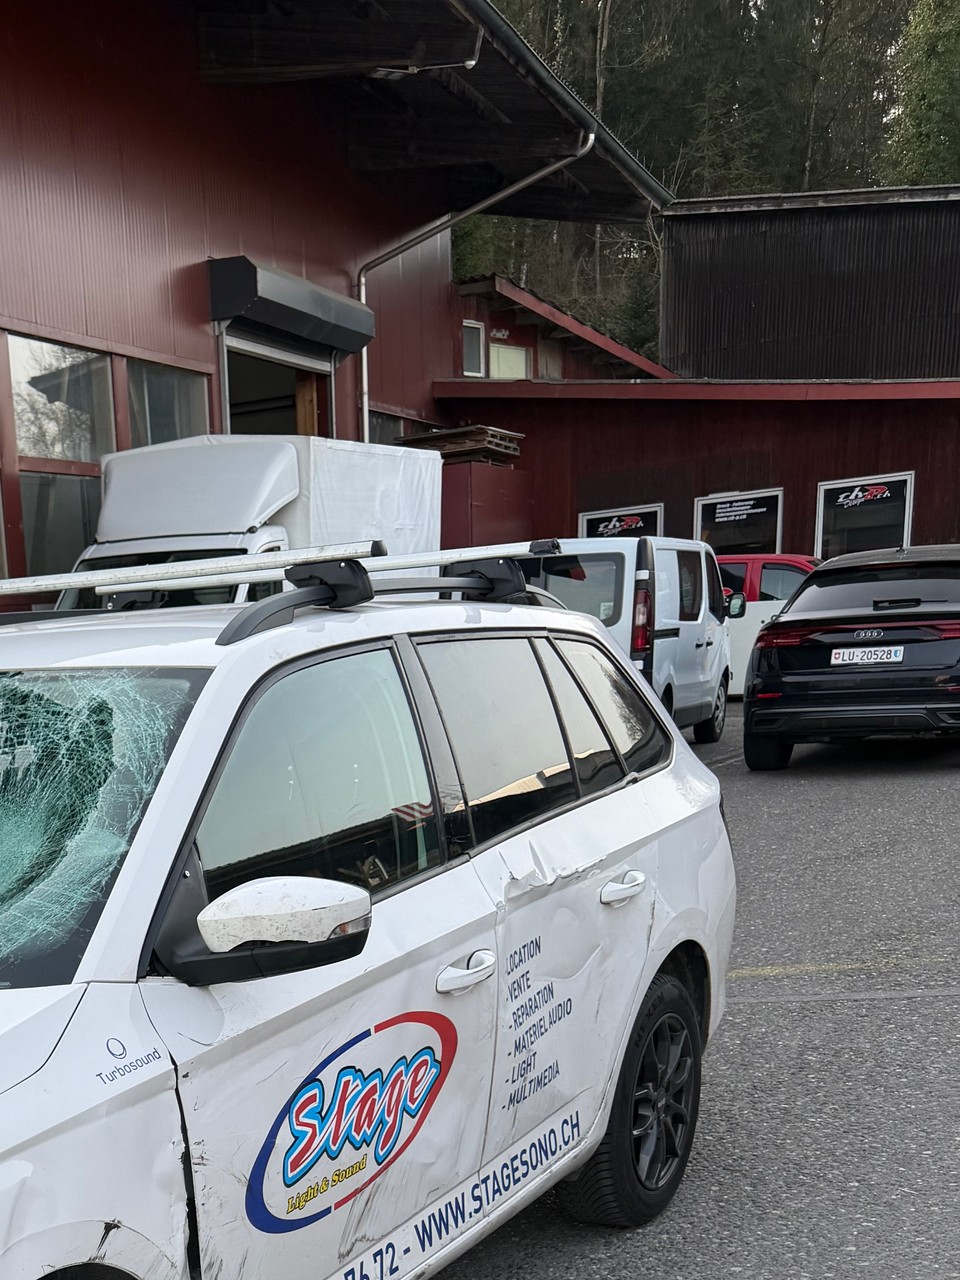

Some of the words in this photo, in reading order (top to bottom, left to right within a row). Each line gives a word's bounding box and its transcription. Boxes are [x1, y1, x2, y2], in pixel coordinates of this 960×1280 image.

[506, 935, 541, 976] LOCATION
[508, 970, 532, 1003] VENTE
[511, 981, 554, 1031] REPARATION
[513, 1015, 549, 1058] MATERIEL
[548, 998, 572, 1029] AUDIO
[95, 1047, 162, 1085] Turbosound
[507, 1059, 560, 1111] MULTIMEDIA
[511, 1051, 537, 1085] LIGHT
[283, 1046, 441, 1187] Stage
[286, 1184, 319, 1214] Light
[319, 1177, 330, 1194] &
[331, 1154, 368, 1188] Sound
[414, 1110, 581, 1253] WWW.STAGESONO.CH
